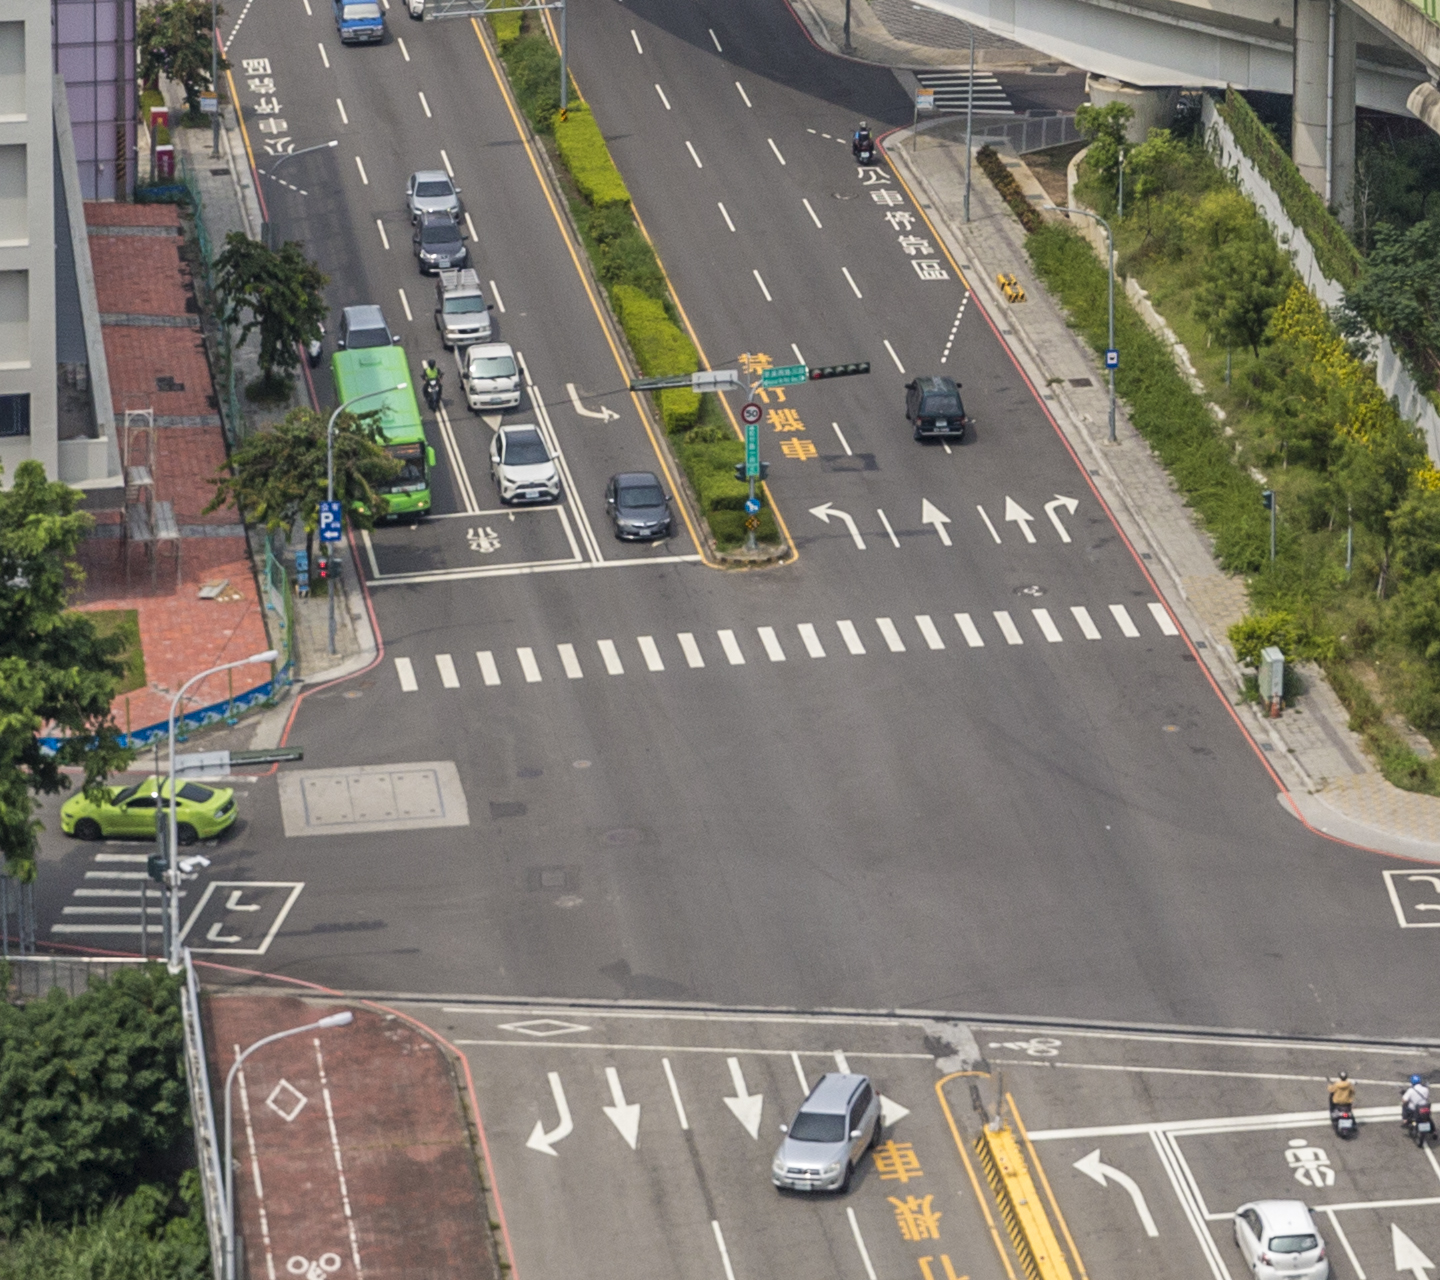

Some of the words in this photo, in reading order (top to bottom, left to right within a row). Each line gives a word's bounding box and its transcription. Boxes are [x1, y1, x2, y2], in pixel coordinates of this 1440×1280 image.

[857, 166, 950, 280] 公車停靠區
[745, 409, 758, 418] 50
[321, 512, 334, 529] P
